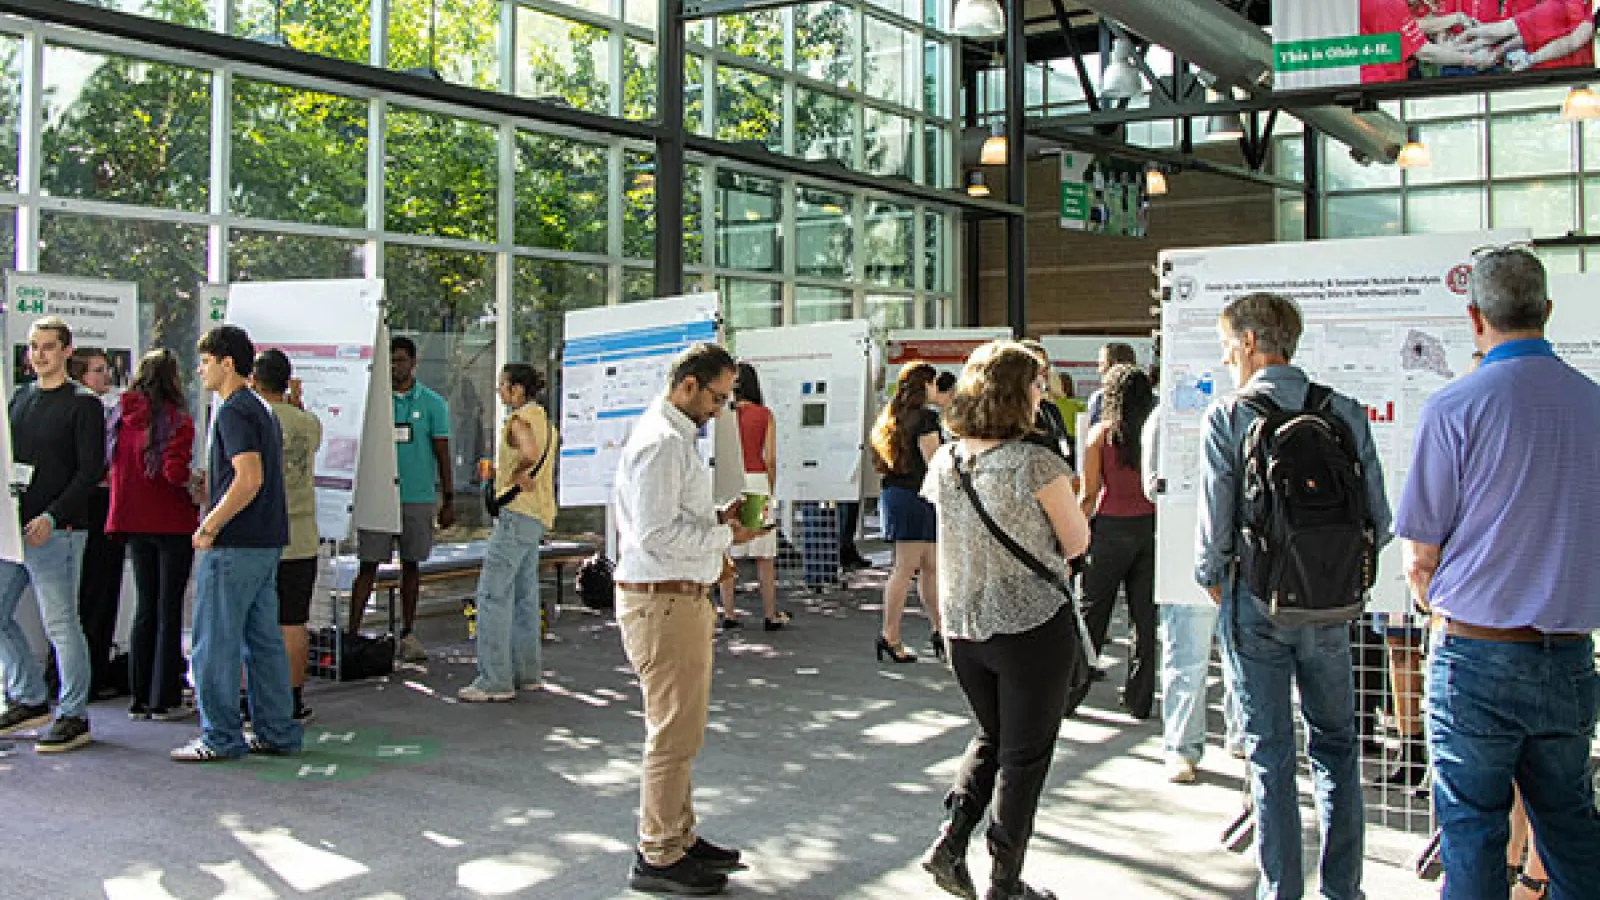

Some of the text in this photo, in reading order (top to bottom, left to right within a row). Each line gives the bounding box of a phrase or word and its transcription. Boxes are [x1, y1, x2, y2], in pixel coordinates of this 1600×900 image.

[1280, 50, 1309, 63] This
[1312, 47, 1323, 60] is
[1326, 44, 1358, 59] Ohio
[16, 299, 44, 314] 4-H
